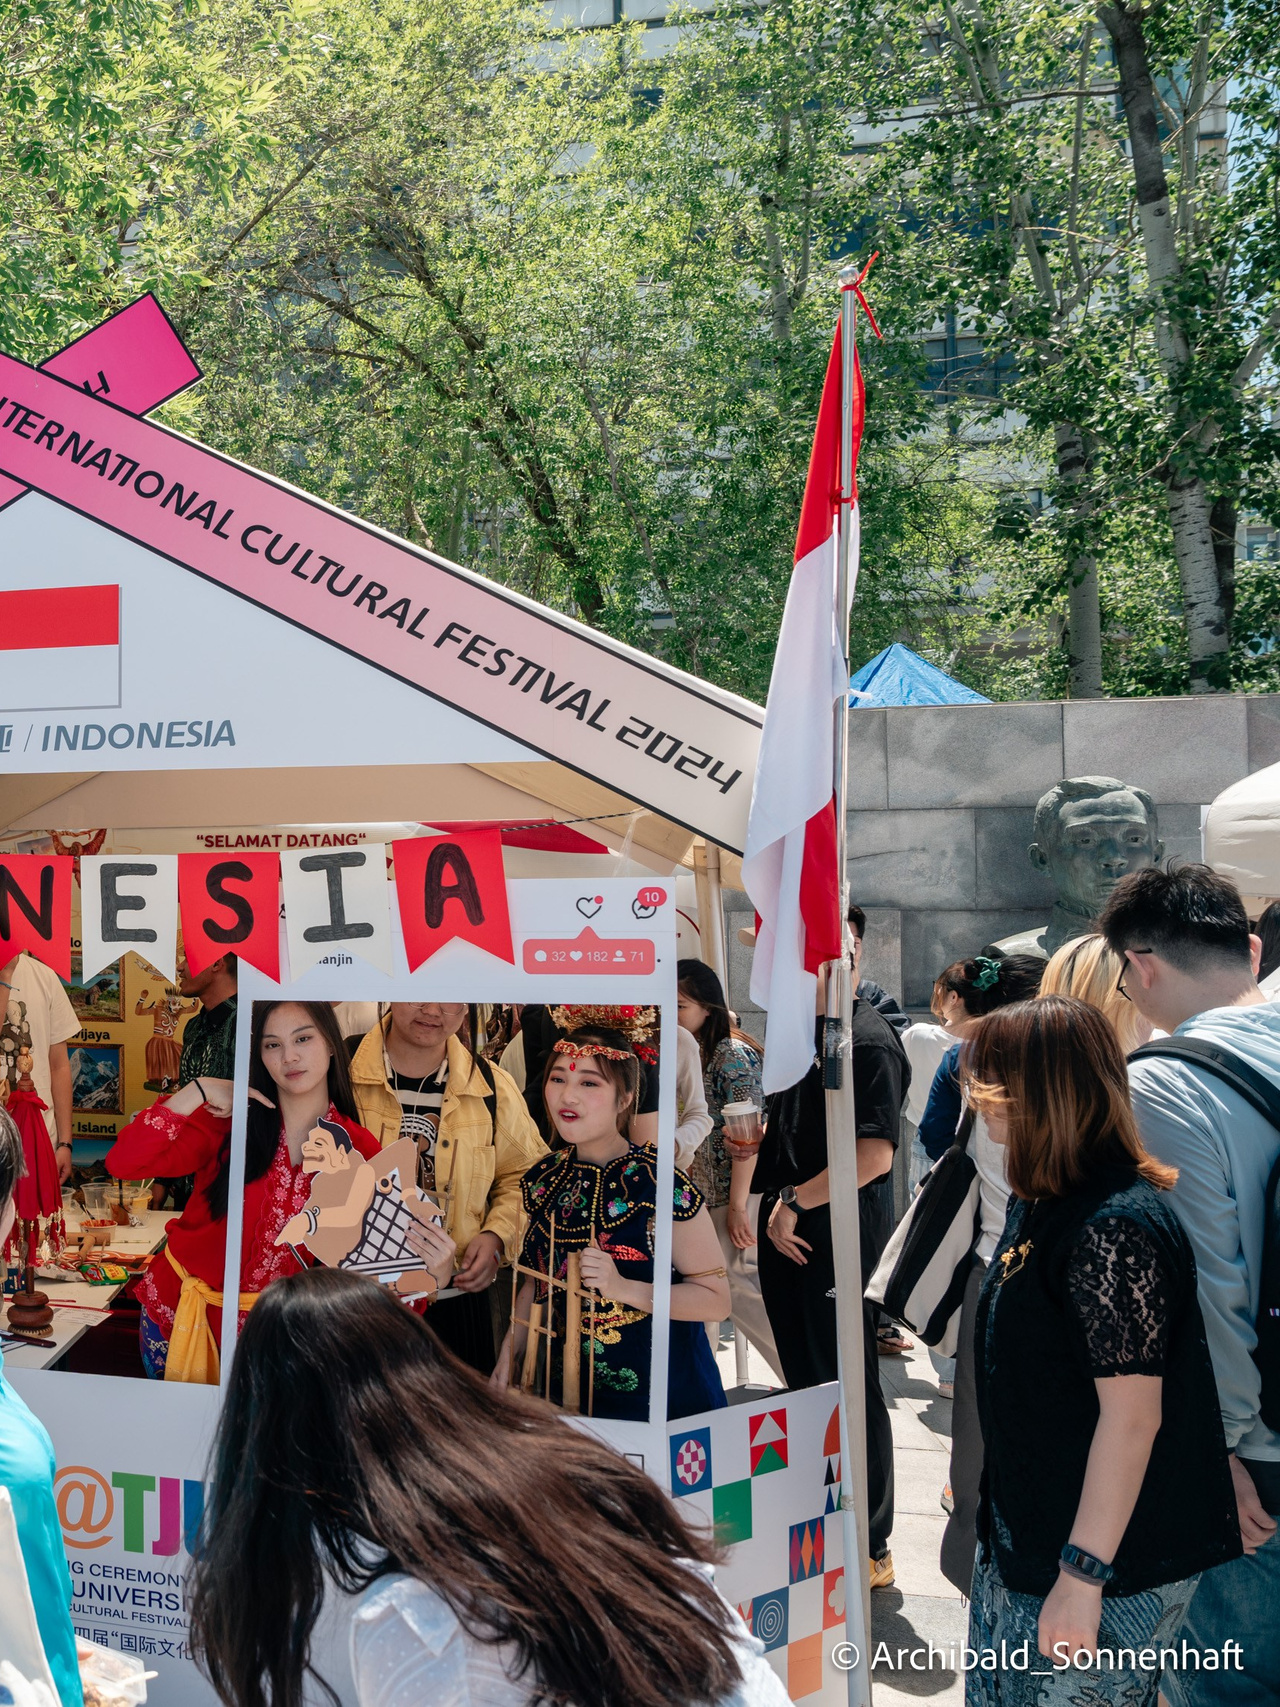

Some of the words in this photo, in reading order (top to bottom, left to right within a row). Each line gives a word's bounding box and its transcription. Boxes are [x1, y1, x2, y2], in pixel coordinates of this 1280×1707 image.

[241, 525, 430, 640] CULTURAL
[433, 622, 611, 732] FESTIVAL
[616, 716, 743, 794] 2024
[41, 719, 236, 752] INDONESIA
[644, 892, 659, 902] 10
[551, 951, 566, 961] 32
[587, 951, 608, 961] 182
[630, 951, 644, 961] 71
[78, 1122, 116, 1134] Island
[89, 1563, 192, 1589] CEREMONY
[131, 1611, 190, 1628] FESTIVAL
